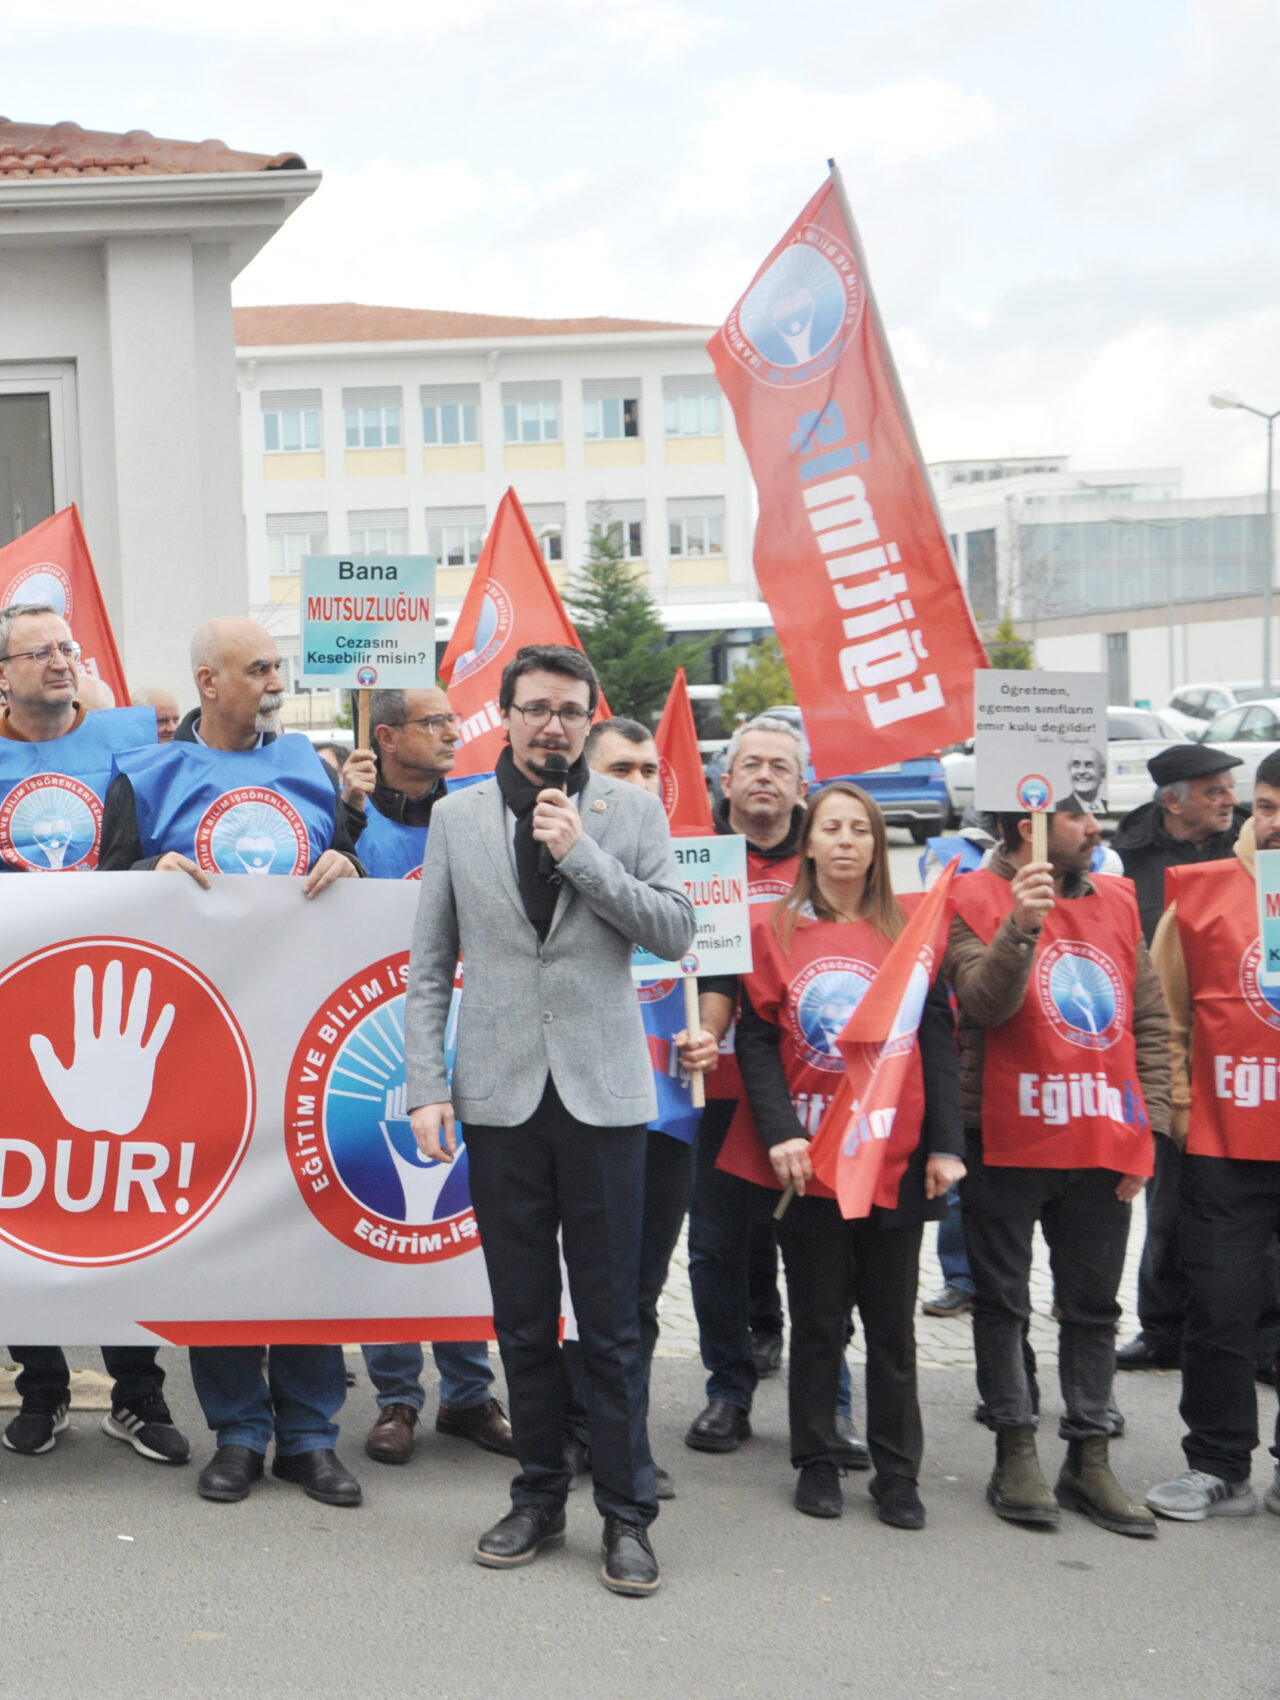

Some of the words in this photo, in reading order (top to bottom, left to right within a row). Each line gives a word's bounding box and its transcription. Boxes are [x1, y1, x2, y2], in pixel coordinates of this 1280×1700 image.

[339, 561, 398, 580] Bana
[307, 591, 430, 621] MUTSUZLUĞUN
[336, 636, 398, 649] Cezasını
[307, 651, 372, 664] Kesebilir
[377, 652, 426, 664] misin?
[1000, 682, 1070, 697] Öğretmen,
[978, 704, 1031, 715] egemen
[1035, 704, 1094, 714] sınıfların
[976, 722, 1005, 731] emir
[1009, 722, 1037, 732] kulu
[675, 848, 711, 864] ana
[697, 935, 742, 950] misin?
[318, 978, 384, 1045] BİLİM
[300, 1048, 327, 1083] VE
[1215, 1055, 1280, 1108] Eği
[293, 1094, 330, 1193] EĞİTİM
[353, 1217, 479, 1255] EĞİTİM-İŞ
